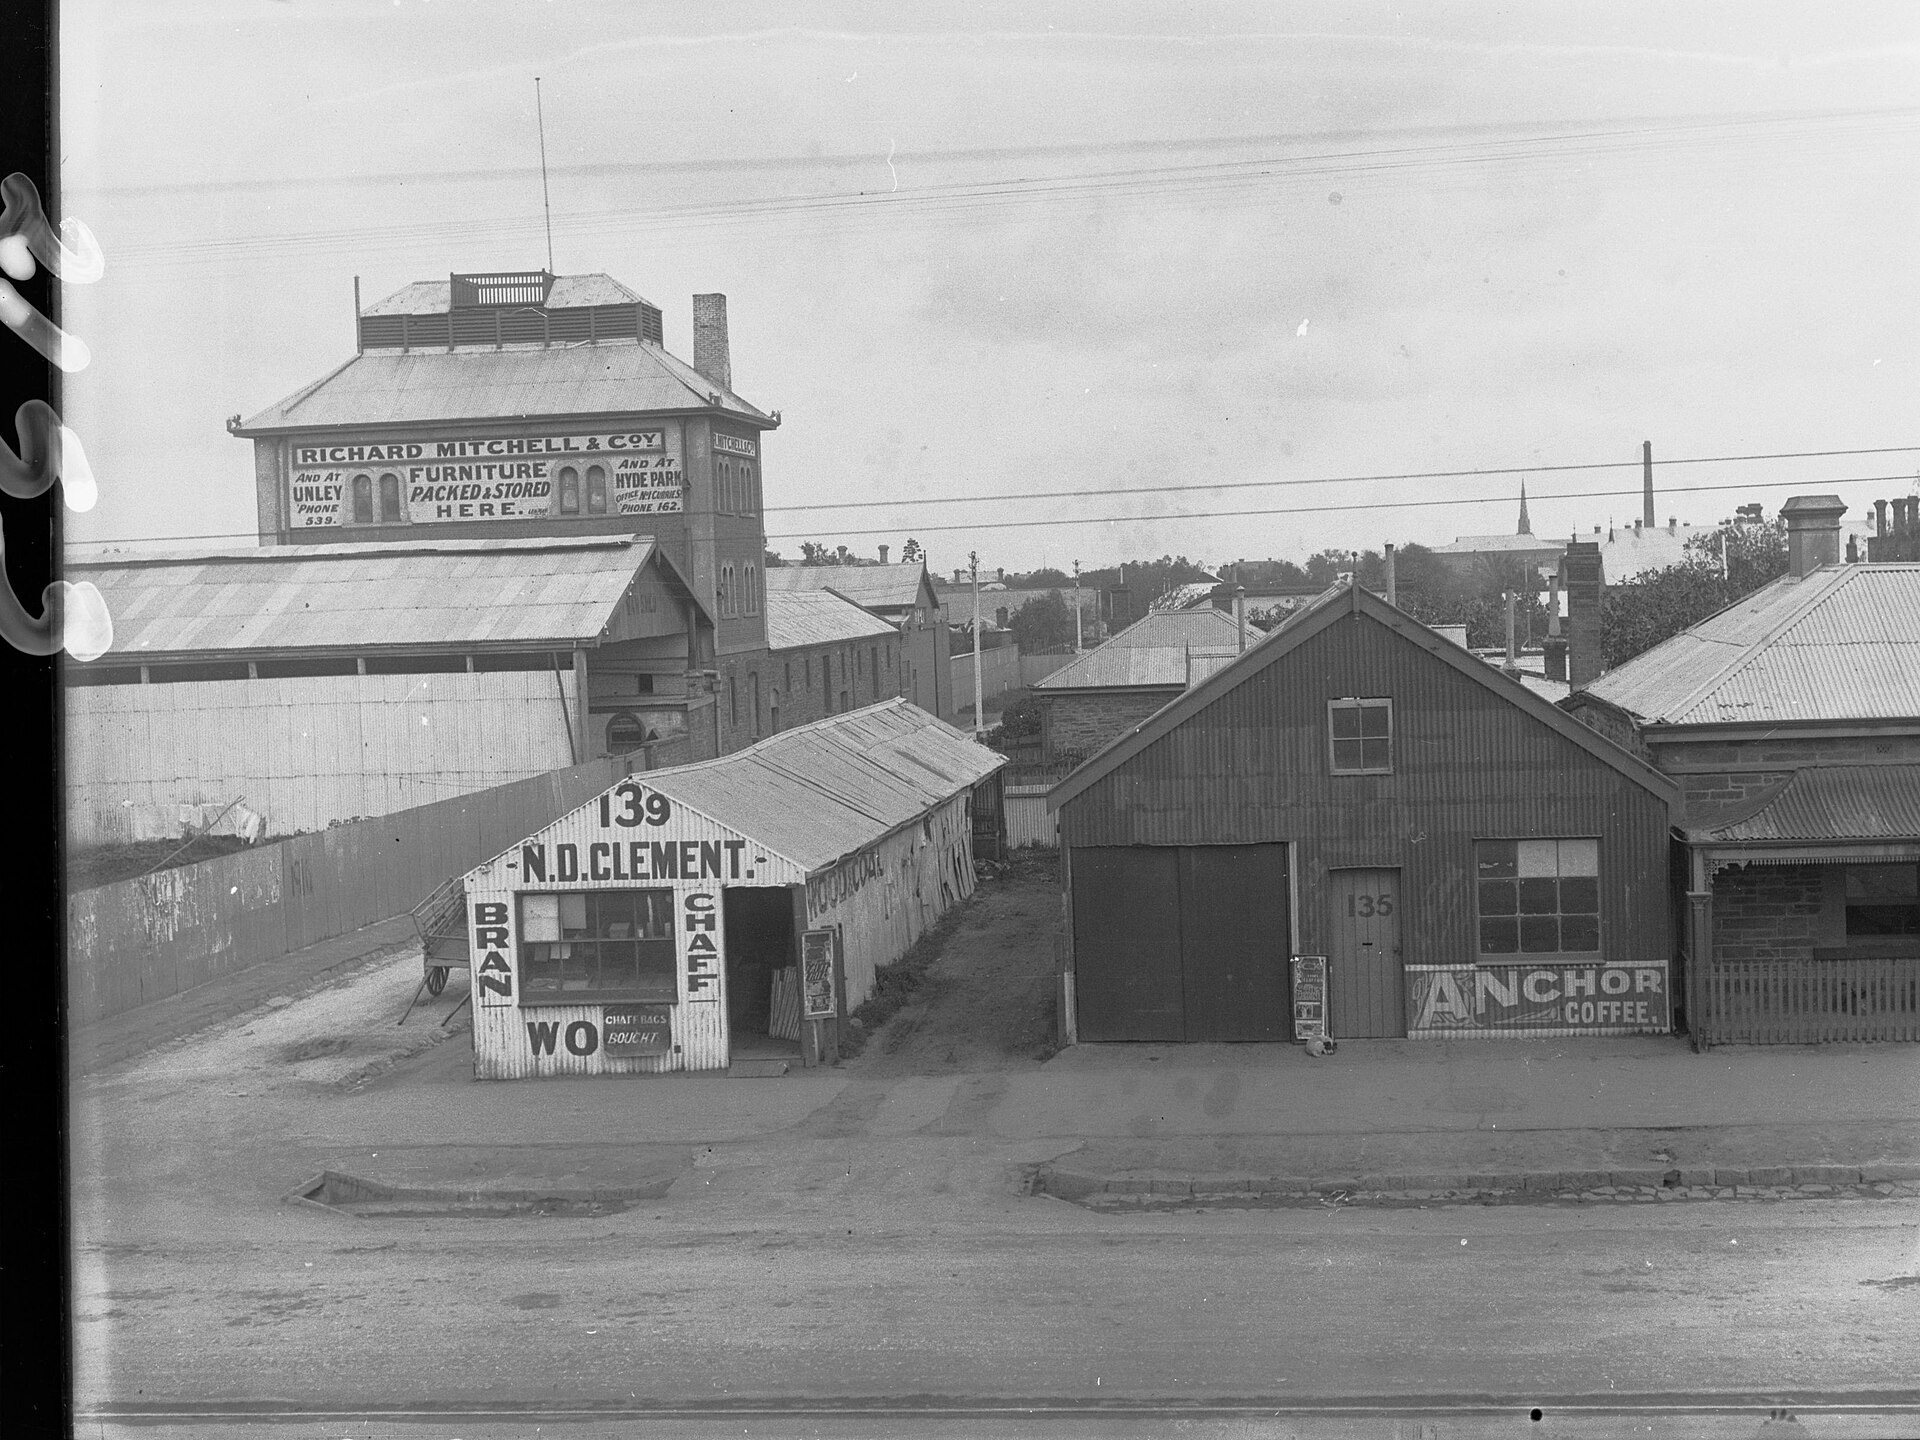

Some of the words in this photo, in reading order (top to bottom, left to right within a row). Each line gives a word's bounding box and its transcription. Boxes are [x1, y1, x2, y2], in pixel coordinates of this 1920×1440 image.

[301, 444, 423, 463] RICHARD
[436, 437, 580, 457] MITCHELL
[586, 437, 600, 450] &
[409, 462, 547, 483] FURNITURE
[618, 459, 649, 469] AND
[655, 457, 675, 467] AT
[295, 472, 320, 483] AND
[324, 472, 341, 482] AT
[616, 472, 648, 488] HYDE
[650, 470, 681, 487] PARK
[293, 485, 342, 502] UNLEY
[437, 502, 523, 518] HERE.
[600, 783, 671, 828] 139
[1347, 893, 1394, 918] 135
[474, 902, 512, 998] BRAN
[684, 893, 718, 993] CHAFF
[1417, 968, 1663, 1029] ANCHOR
[1565, 1001, 1657, 1024] COFFEE.
